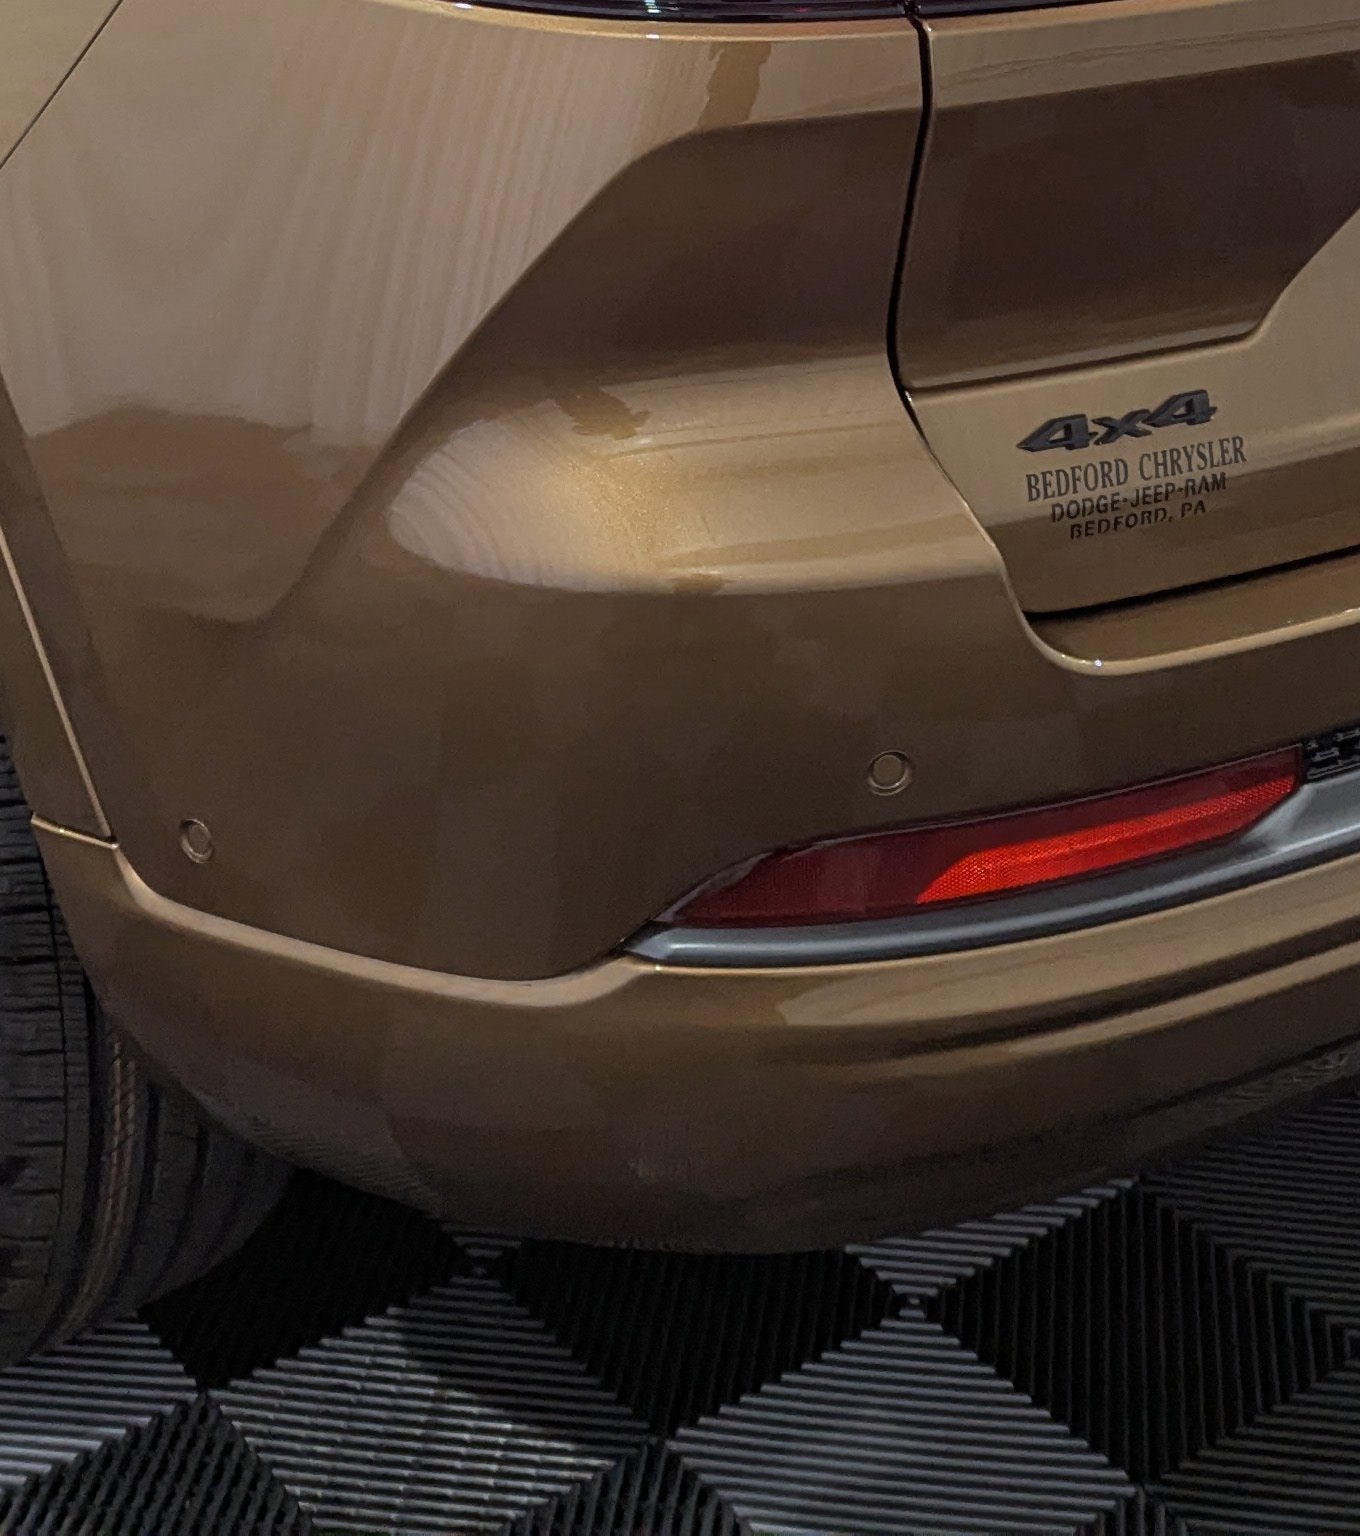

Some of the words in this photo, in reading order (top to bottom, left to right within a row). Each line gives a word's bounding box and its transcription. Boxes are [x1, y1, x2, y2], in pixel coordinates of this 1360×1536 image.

[1016, 389, 1218, 451] 4x4
[1026, 458, 1129, 502] BEDFORD
[1139, 435, 1247, 481] CHRYSLER
[1070, 507, 1173, 540] BEDFORD,
[1181, 500, 1207, 519] PA
